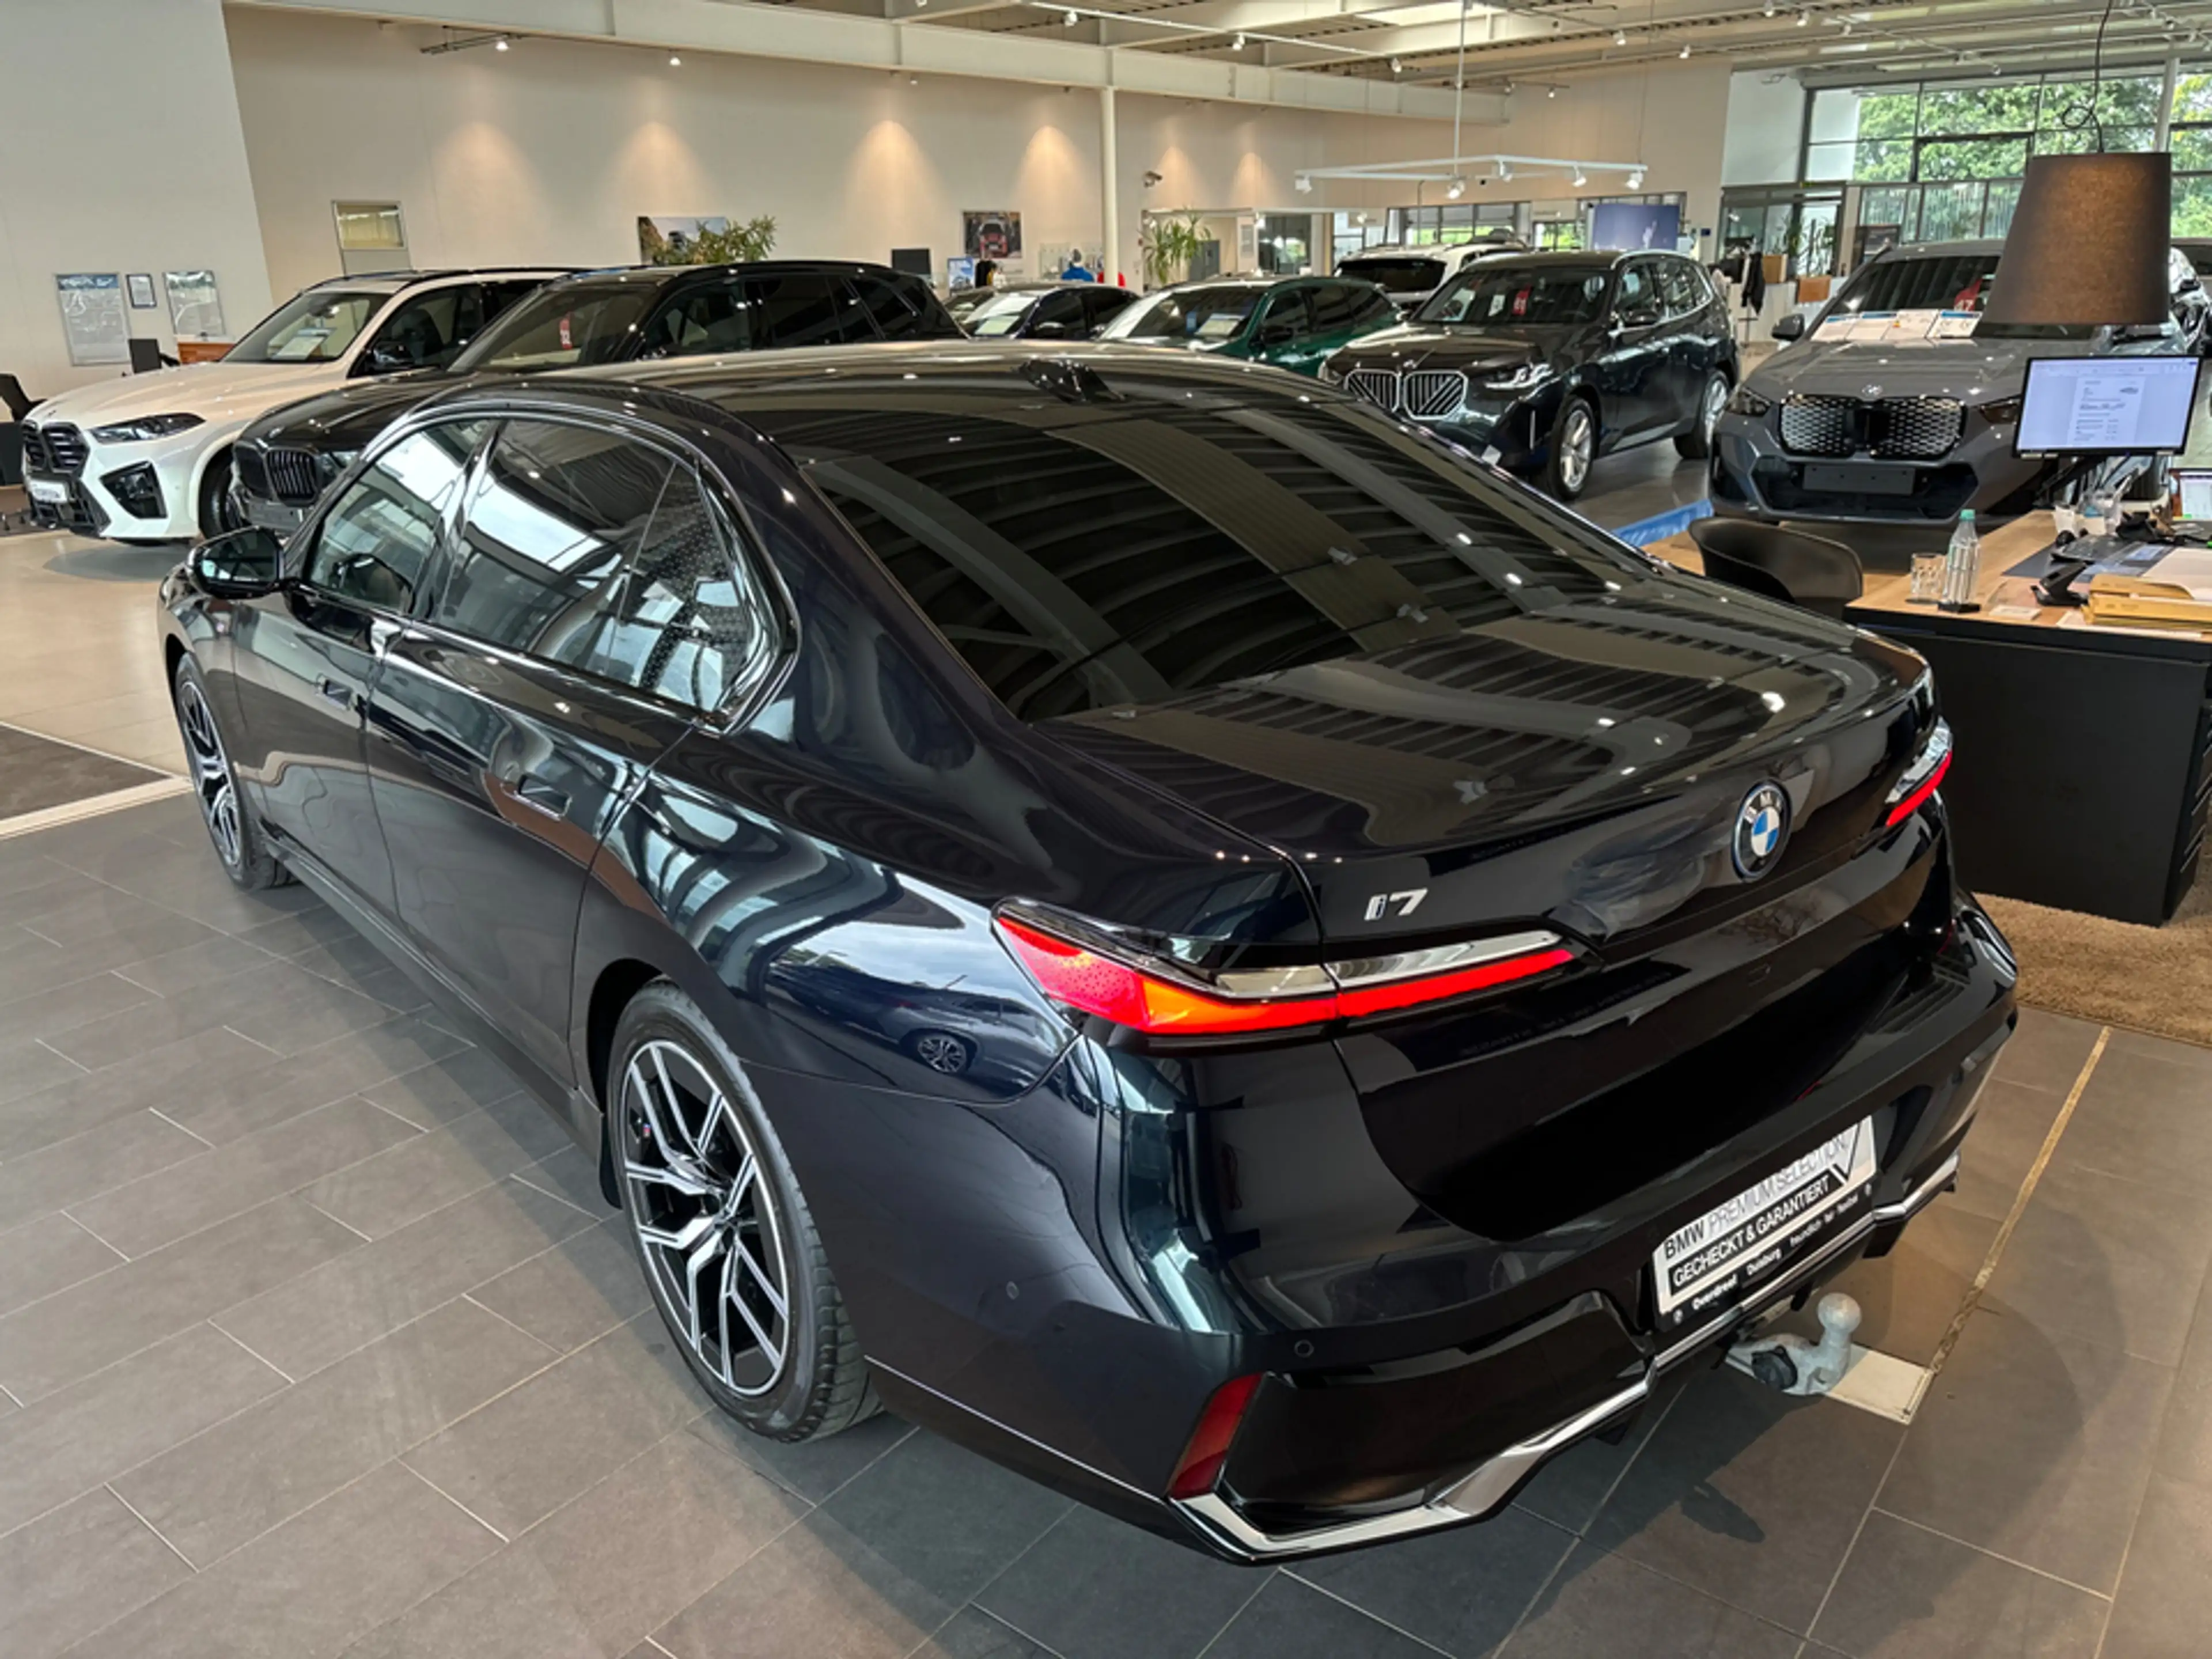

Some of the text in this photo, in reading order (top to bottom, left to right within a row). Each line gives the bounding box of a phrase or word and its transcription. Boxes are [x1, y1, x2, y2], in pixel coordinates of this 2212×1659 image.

[1364, 888, 1427, 921] i7
[1664, 1134, 1848, 1260] BMW PREMIUM SELECTION
[1673, 1174, 1830, 1287] GECHECKT & GARANTIERT
